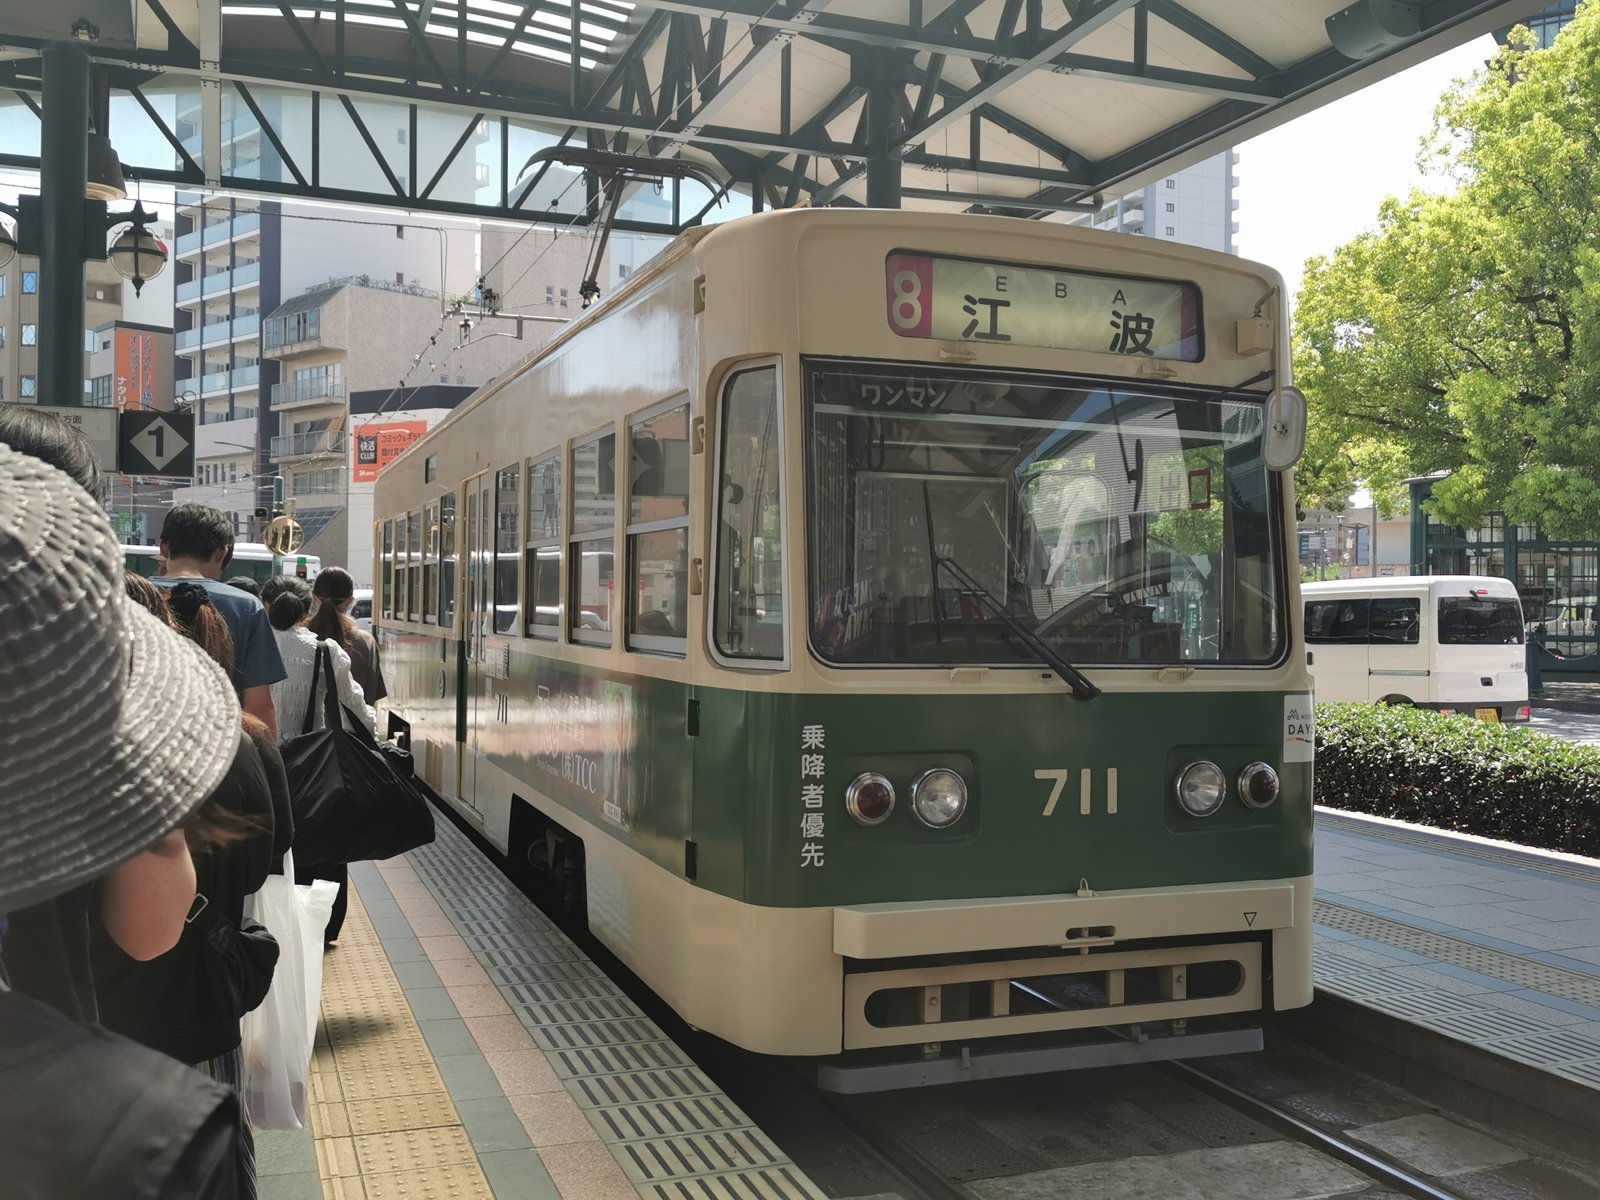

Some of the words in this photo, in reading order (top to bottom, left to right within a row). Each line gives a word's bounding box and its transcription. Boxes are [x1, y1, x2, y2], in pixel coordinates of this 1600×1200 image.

[892, 270, 923, 330] 8
[861, 383, 948, 408] ワンマン
[147, 425, 164, 457] 1
[360, 440, 375, 451] 快活
[360, 452, 375, 460] CLUB
[800, 724, 826, 868] 乗降者優先
[1034, 767, 1119, 817] 711
